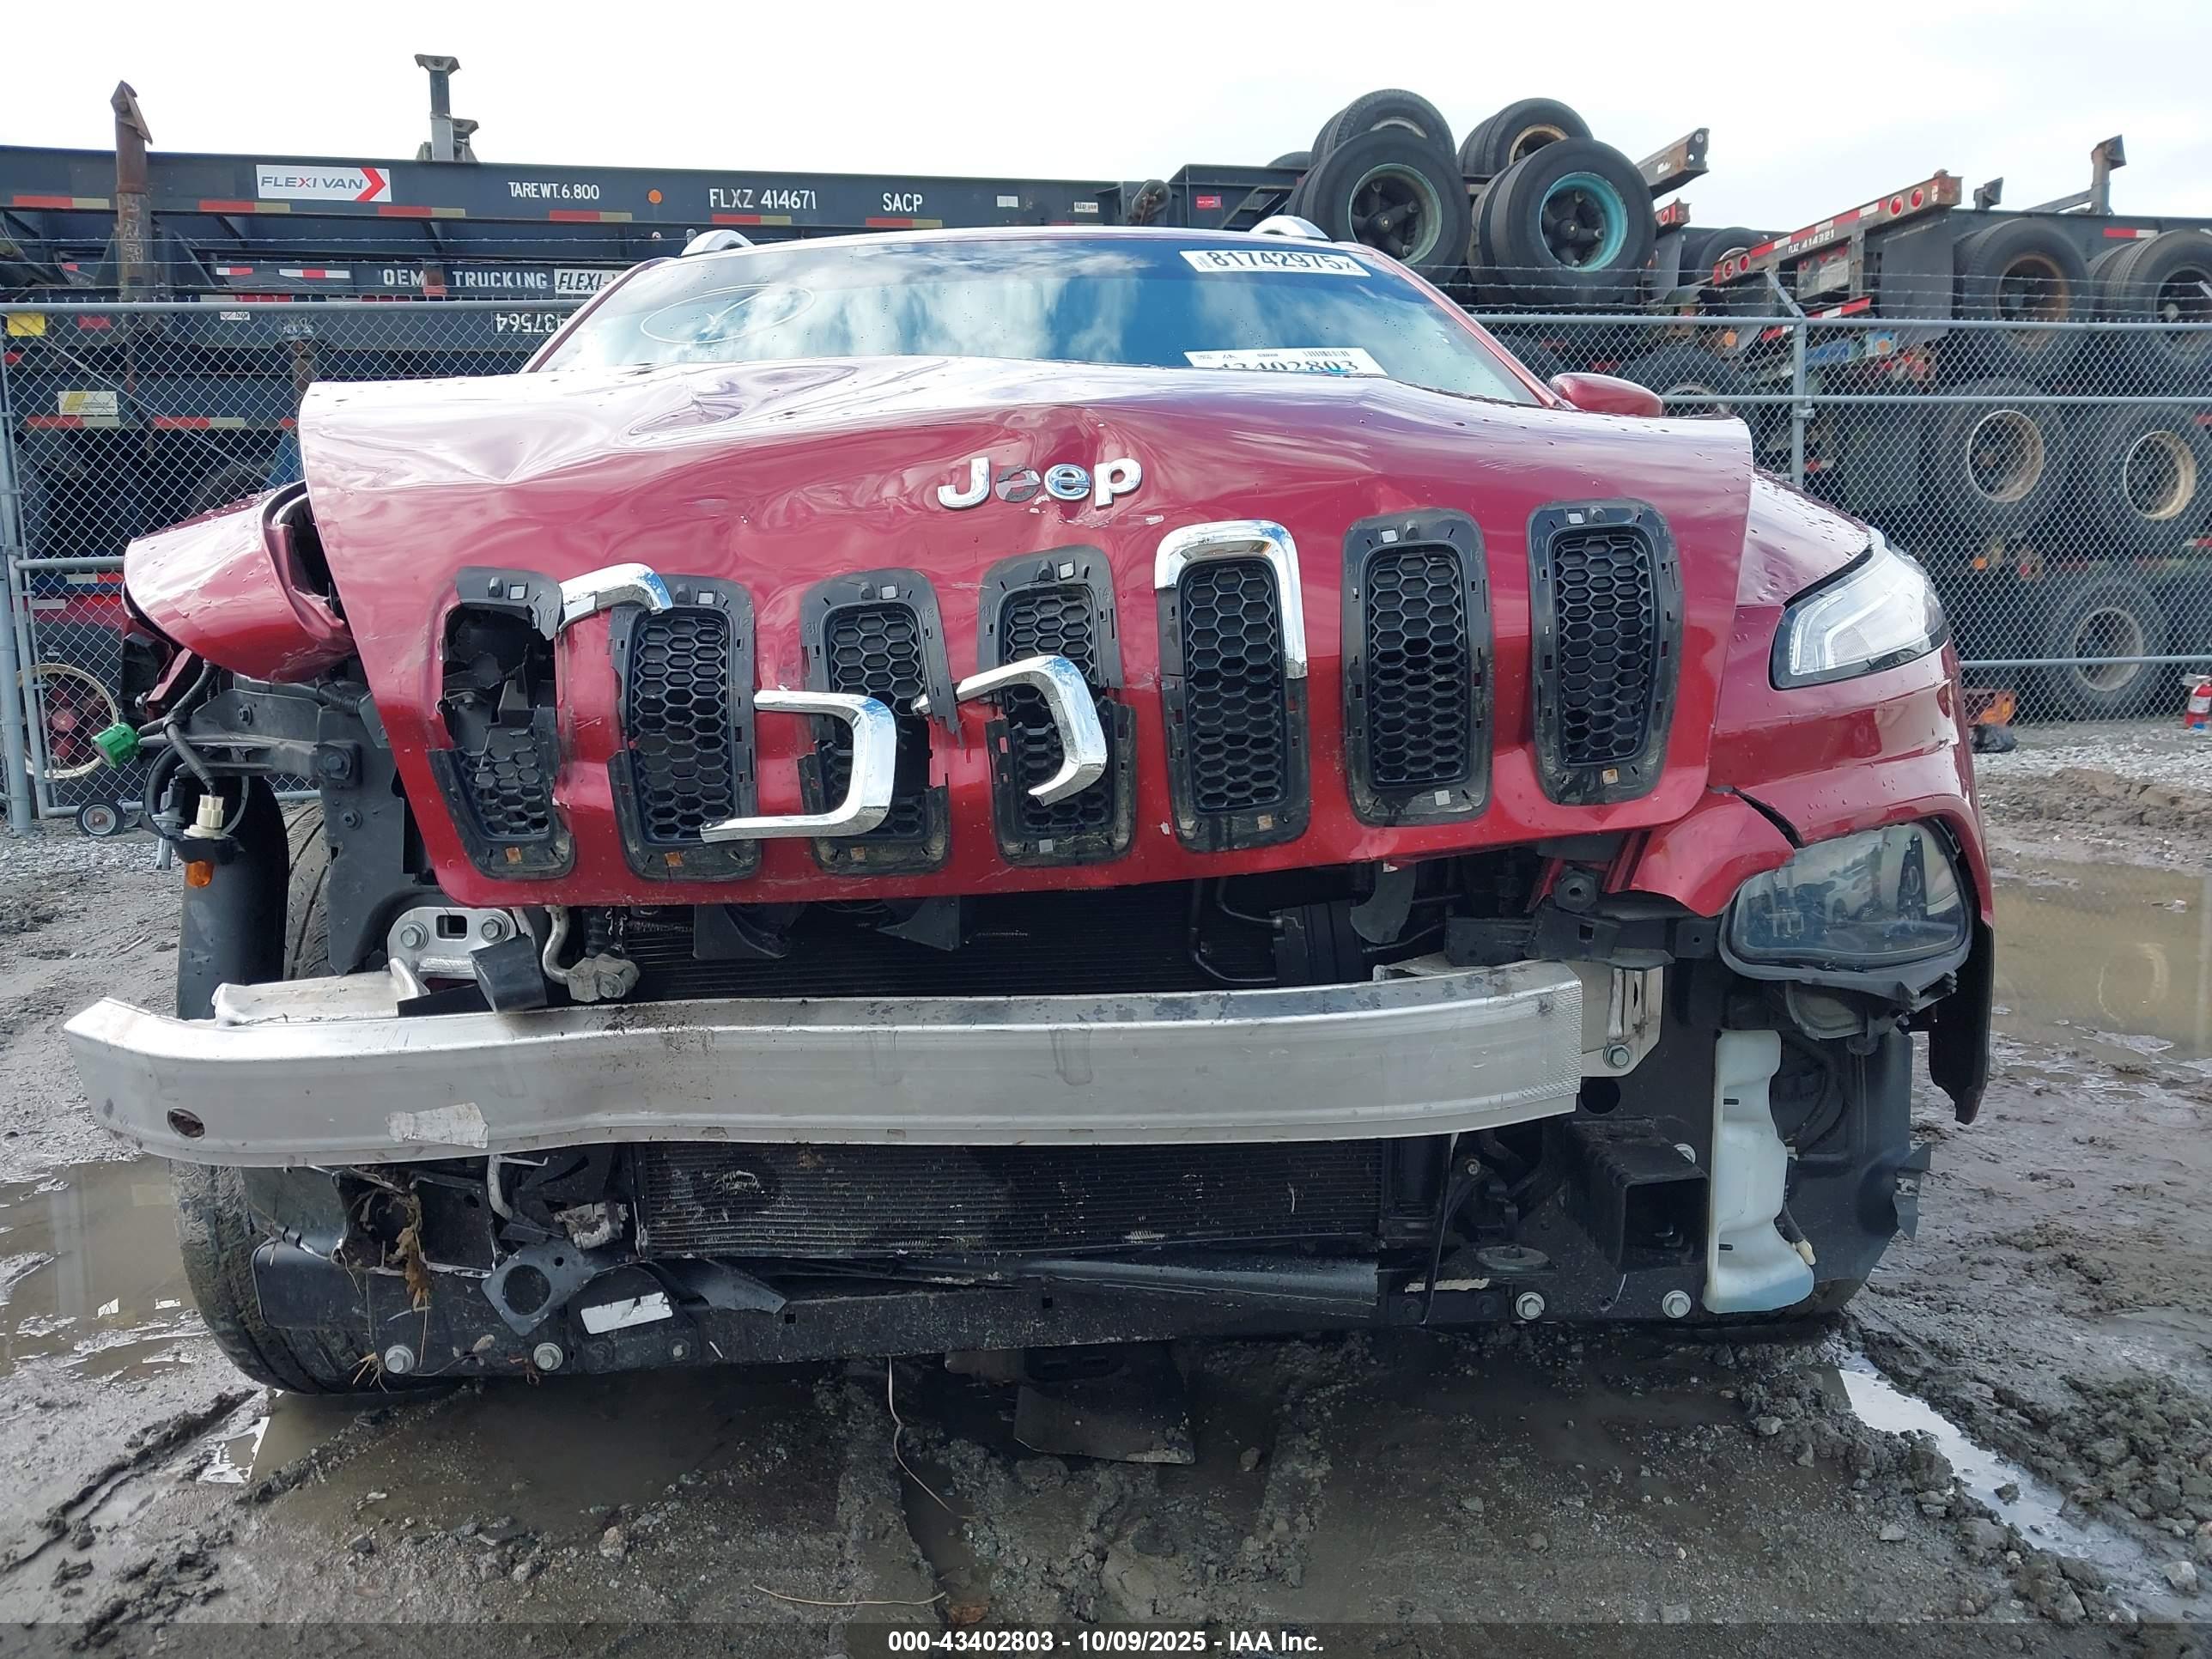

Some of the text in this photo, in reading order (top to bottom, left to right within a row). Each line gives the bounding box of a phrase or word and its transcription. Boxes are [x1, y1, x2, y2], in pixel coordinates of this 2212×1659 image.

[261, 176, 363, 190] FLEXI VAN
[709, 188, 817, 210] FLXZ 414671
[882, 192, 923, 213] SACP
[452, 270, 548, 289] TRUCKING
[937, 456, 1142, 511] Jeep
